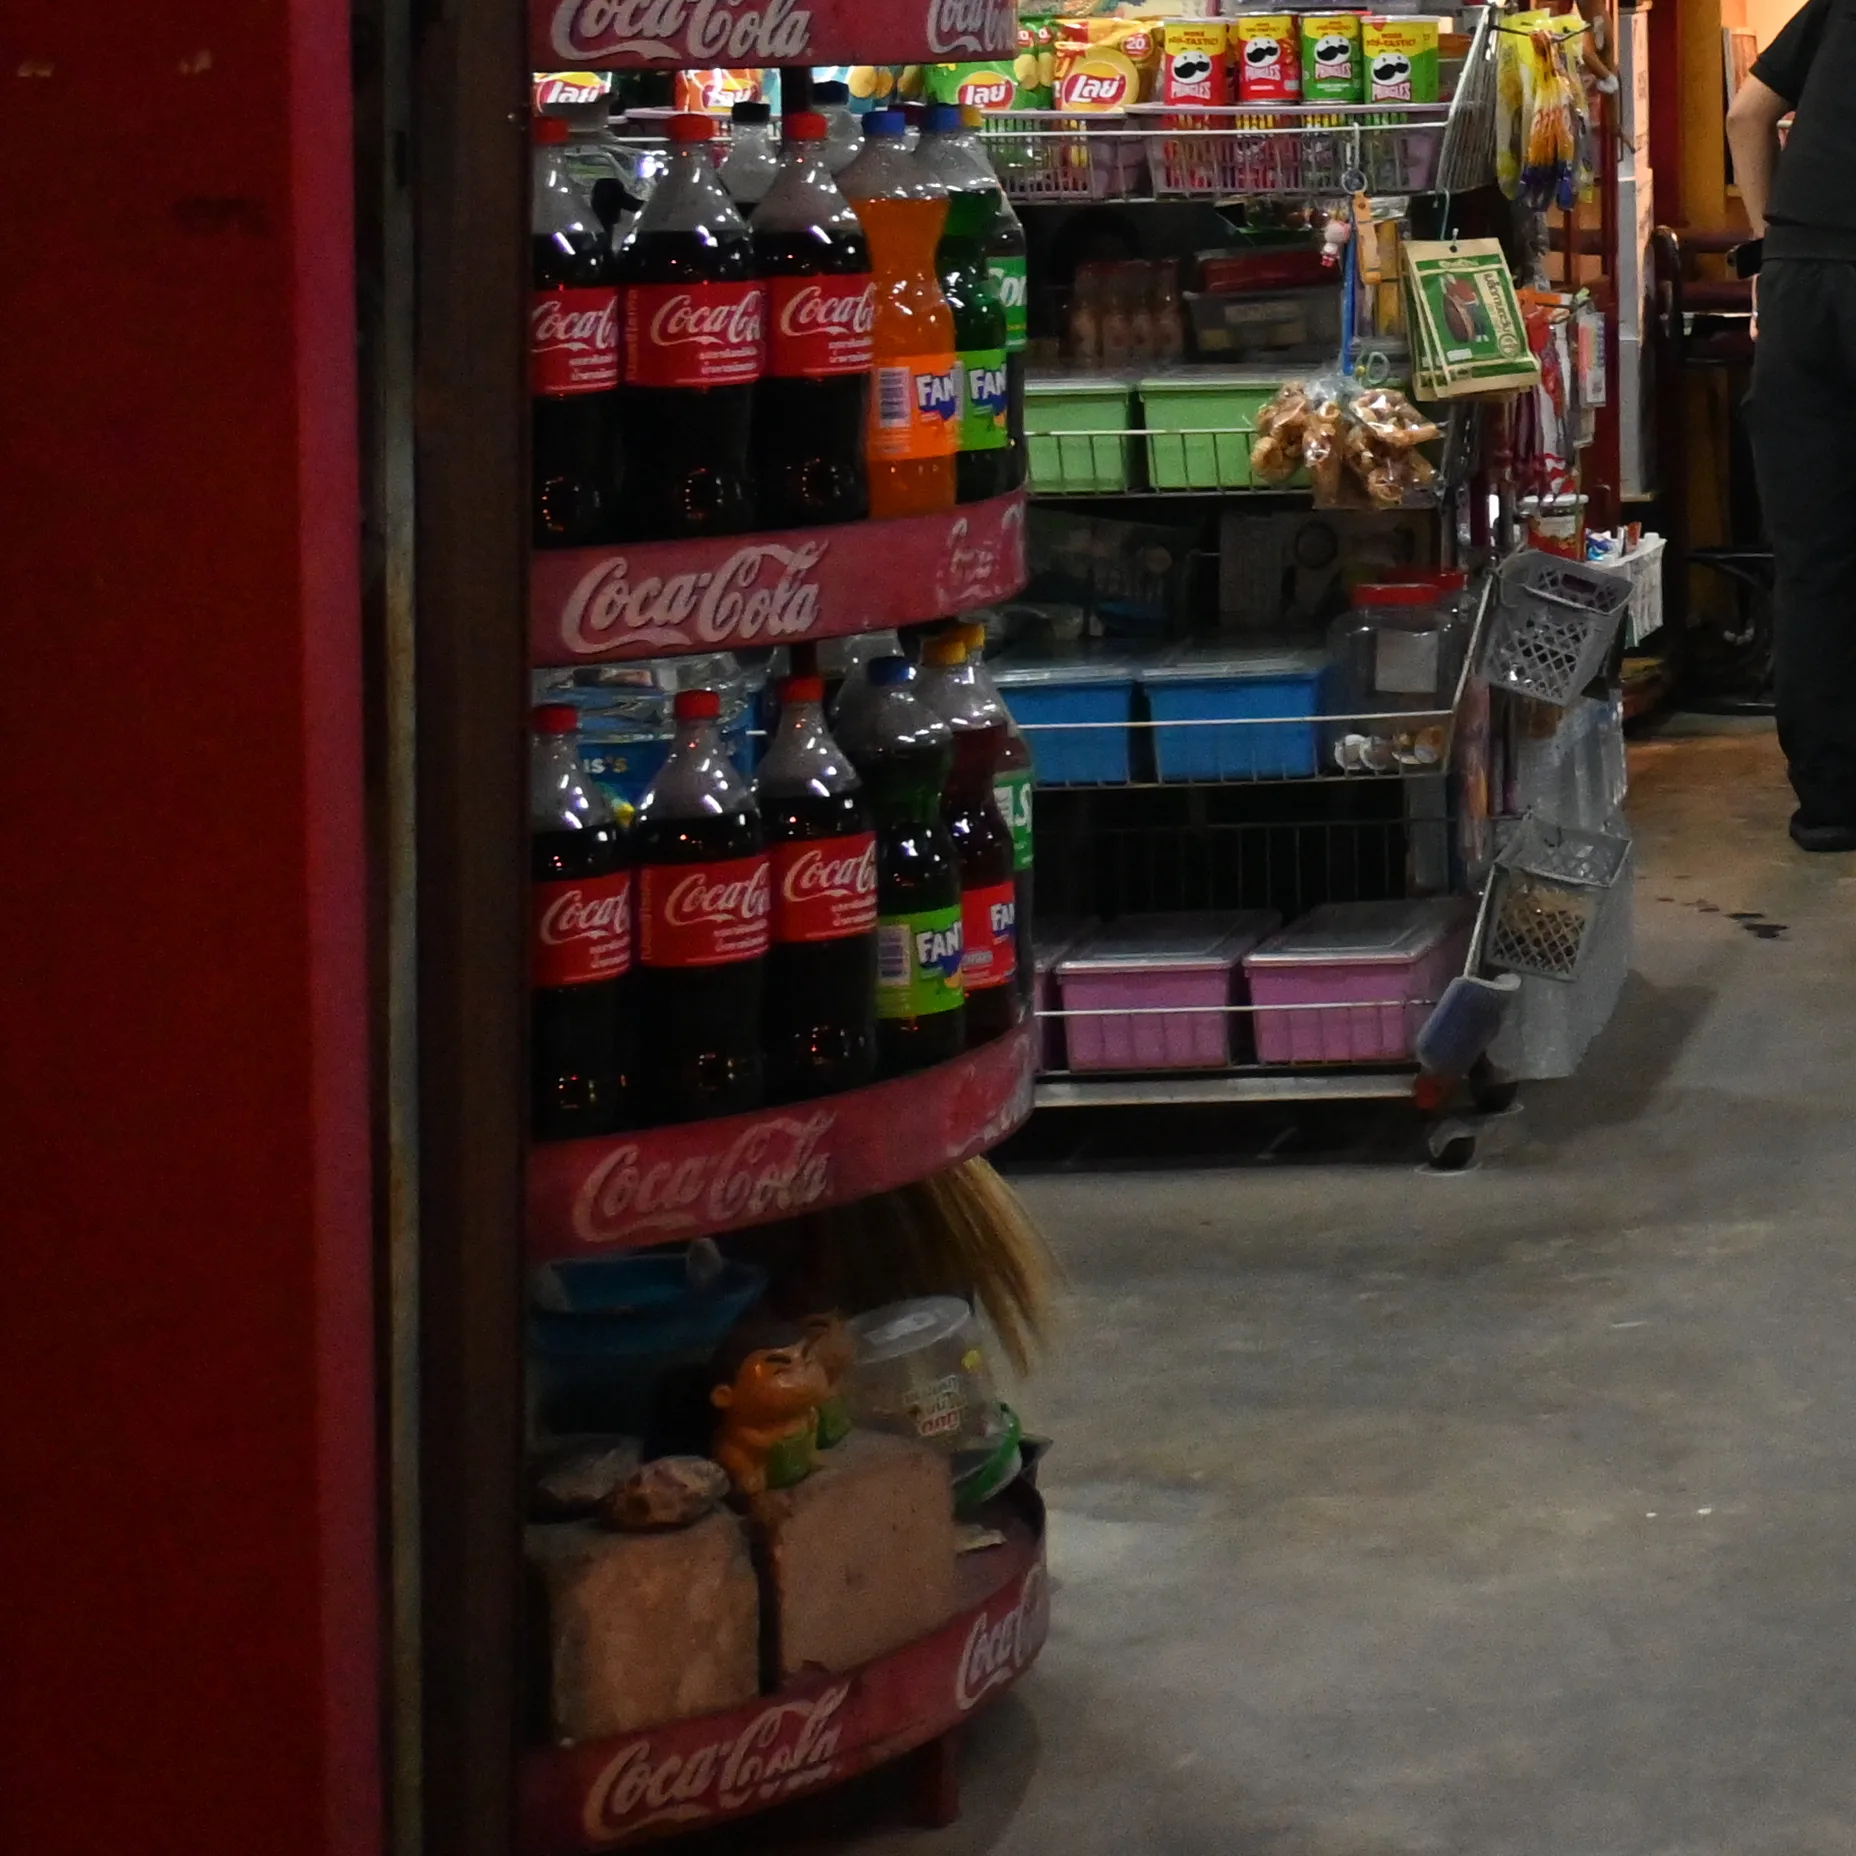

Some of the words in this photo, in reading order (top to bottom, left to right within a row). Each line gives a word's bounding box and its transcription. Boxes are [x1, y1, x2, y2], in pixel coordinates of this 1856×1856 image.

[1127, 37, 1146, 49] 20
[561, 538, 829, 654] Coca-Cola
[573, 1109, 837, 1243] Coca-Cola
[585, 1681, 854, 1841] Coca-Cola
